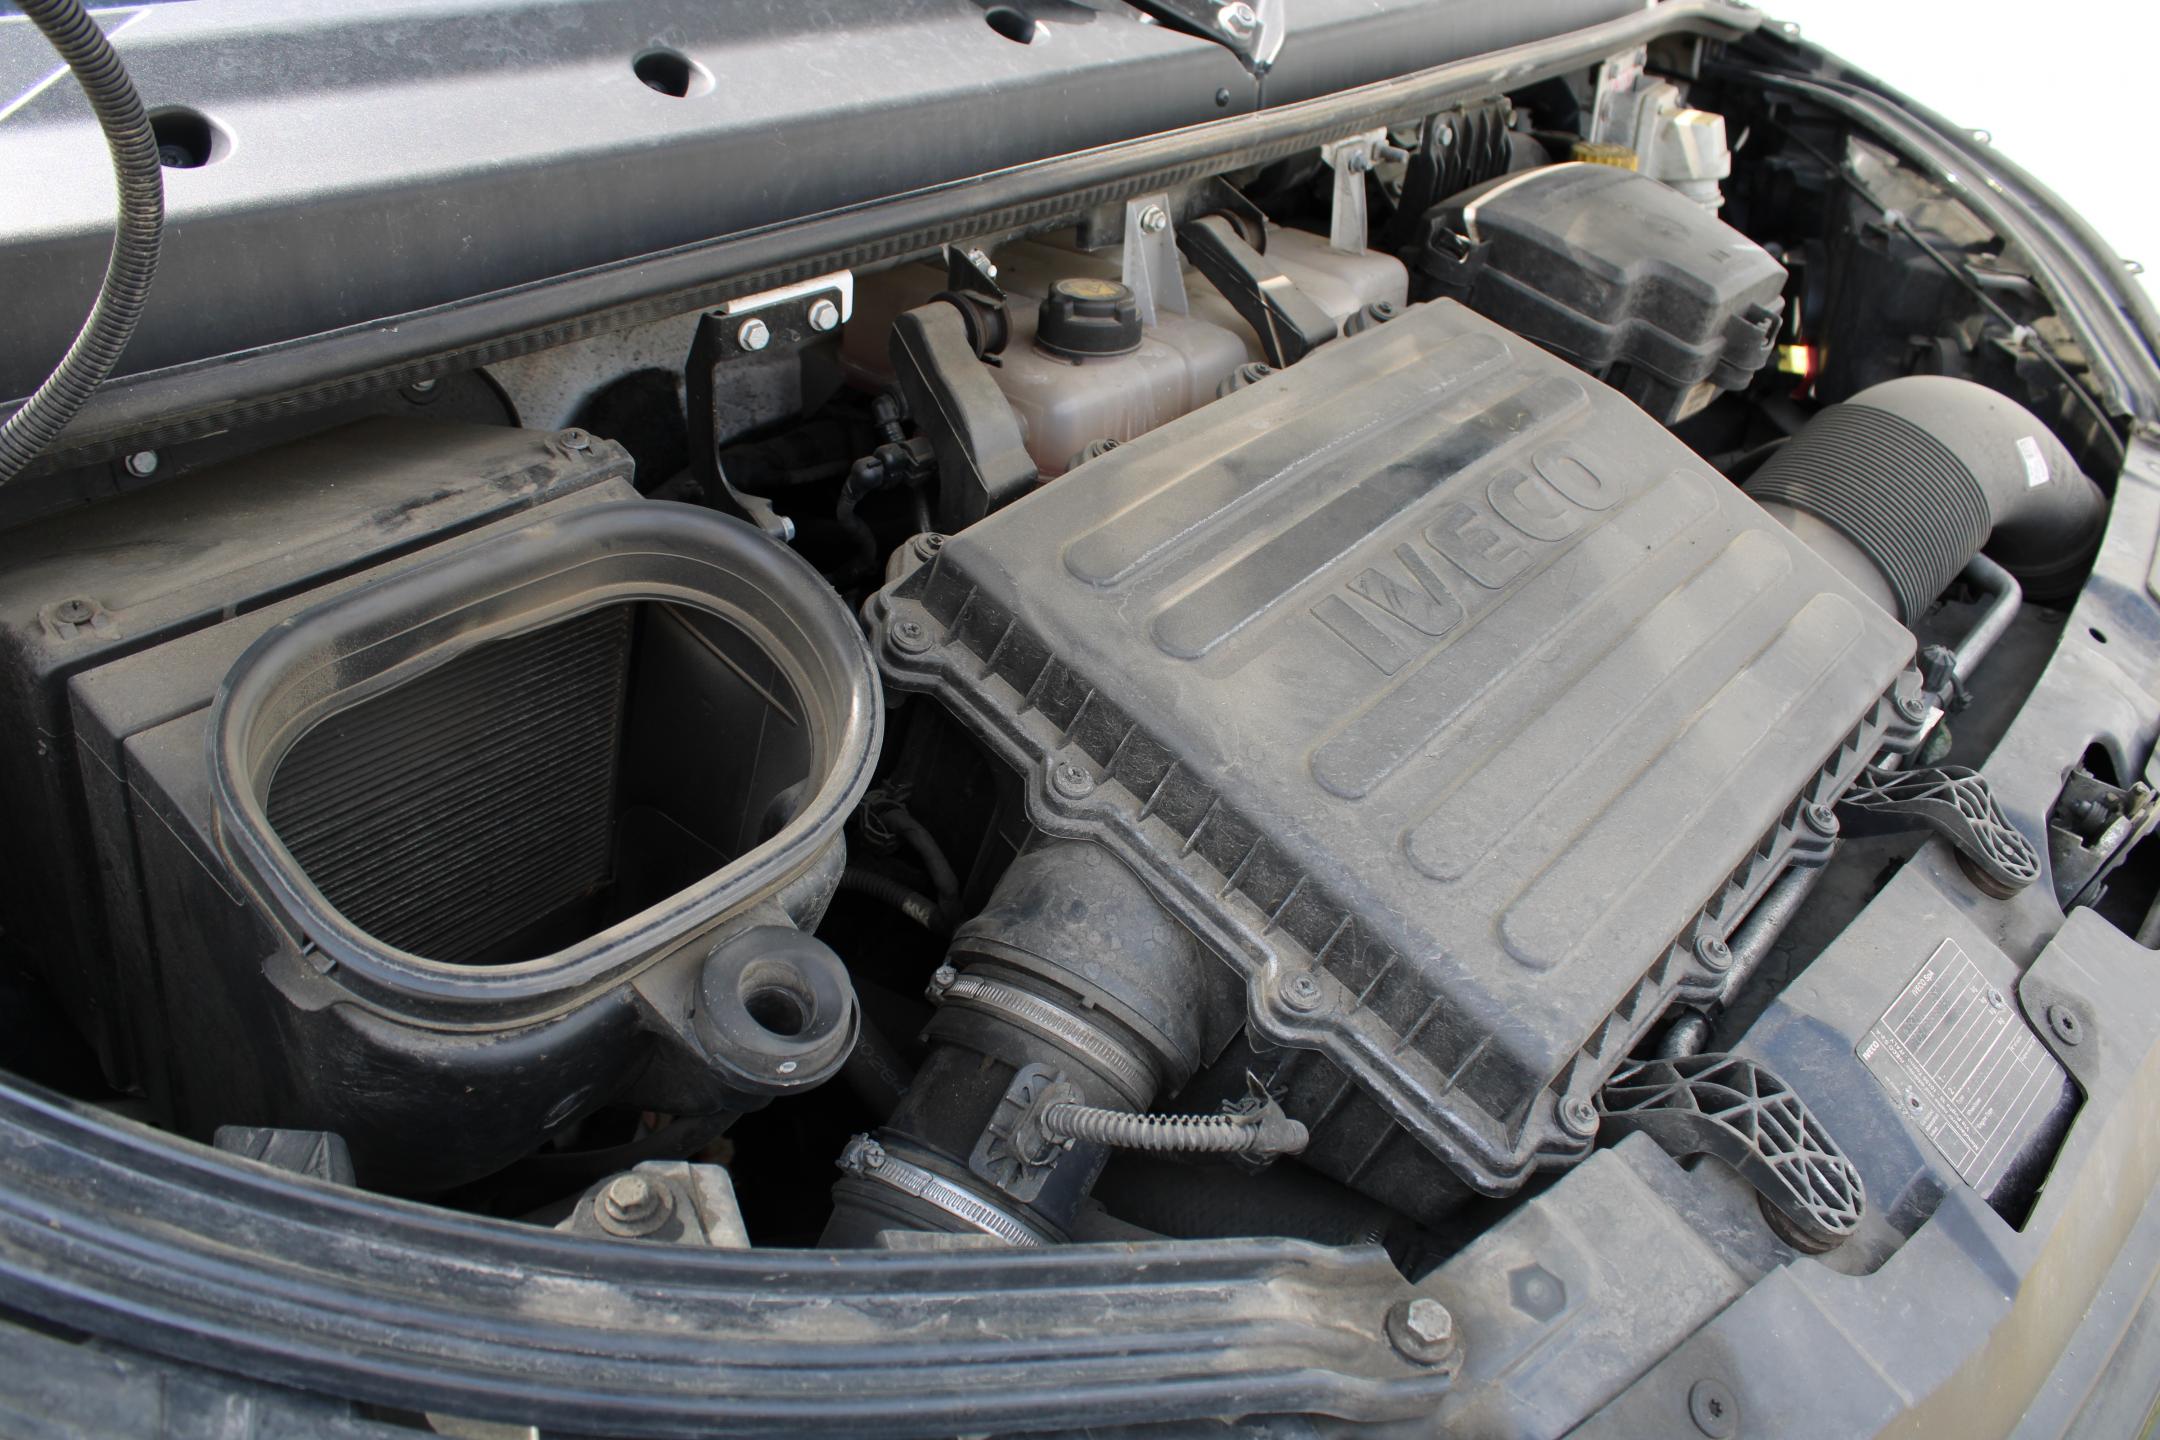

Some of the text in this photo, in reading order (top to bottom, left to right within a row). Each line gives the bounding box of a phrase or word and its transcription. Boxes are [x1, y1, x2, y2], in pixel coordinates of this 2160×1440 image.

[1309, 441, 1625, 676] IVECO
[1911, 978, 1926, 996] IVECO
[1862, 1039, 1879, 1061] IVECO
[1889, 1036, 1905, 1056] ITALY
